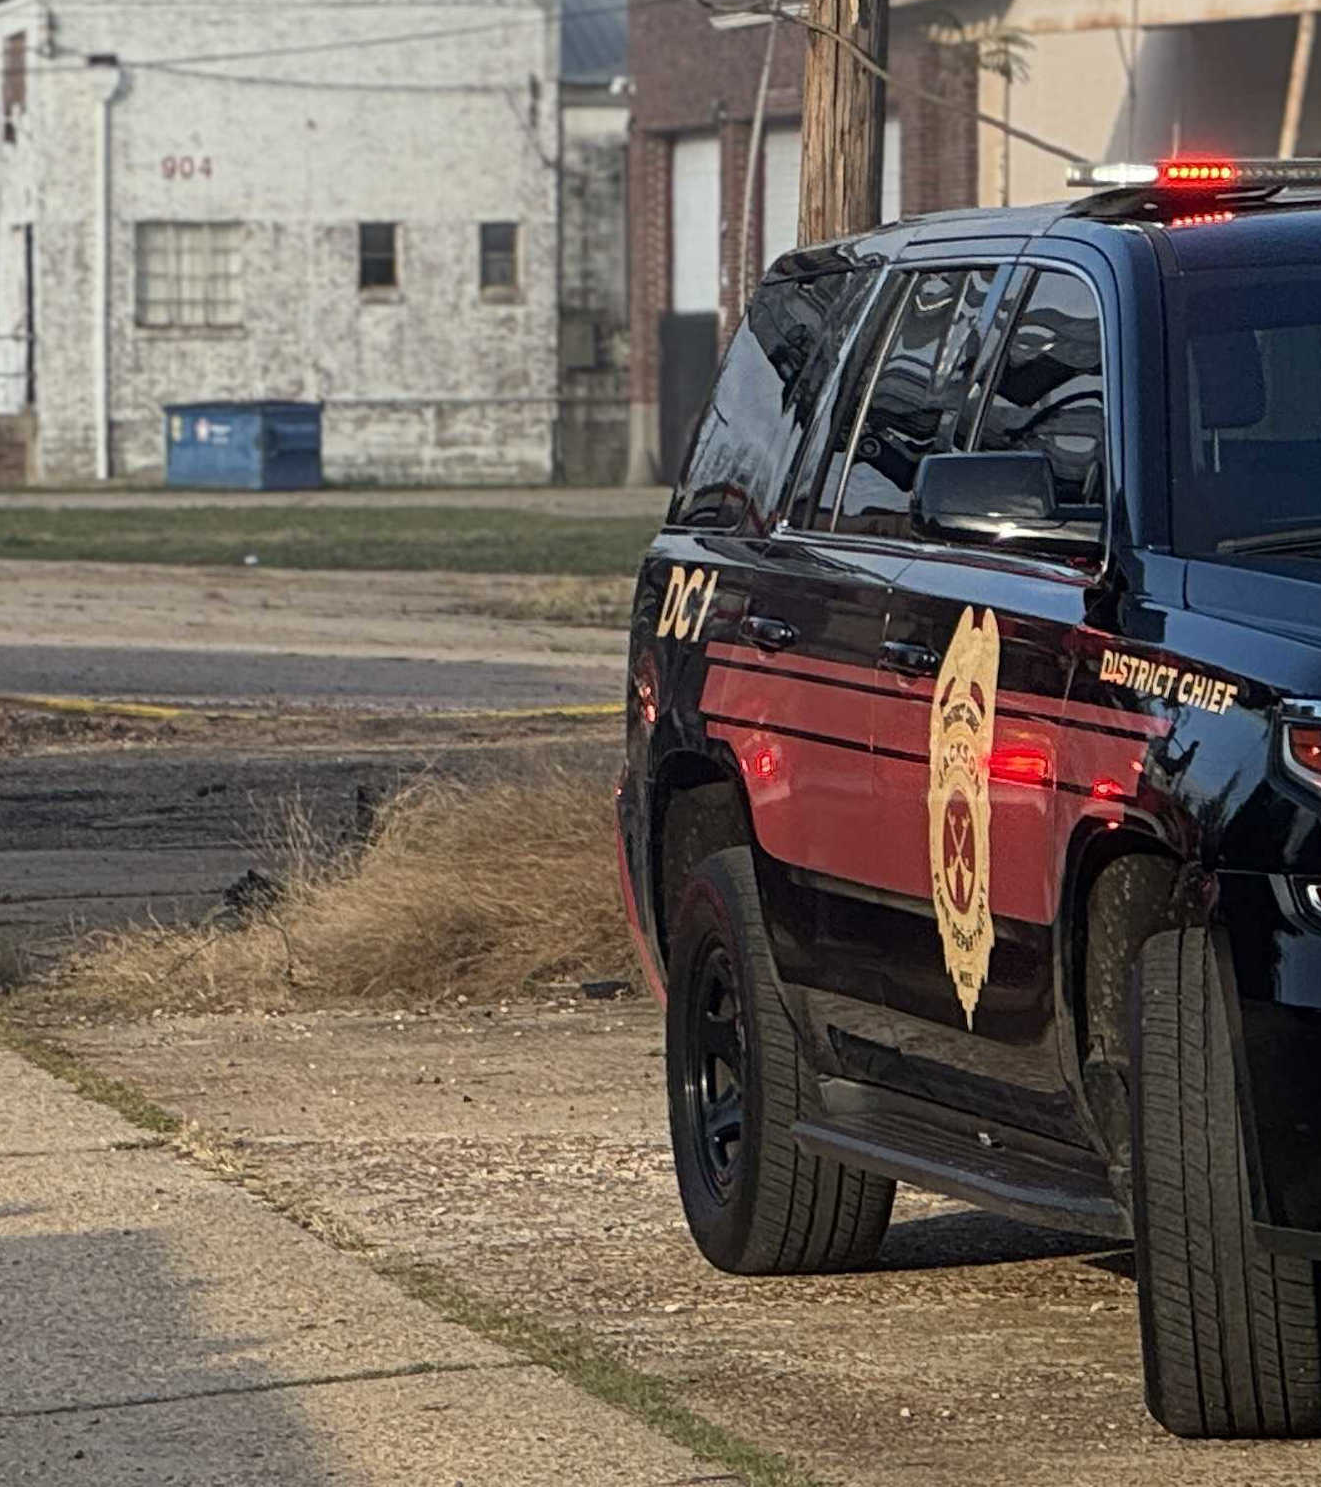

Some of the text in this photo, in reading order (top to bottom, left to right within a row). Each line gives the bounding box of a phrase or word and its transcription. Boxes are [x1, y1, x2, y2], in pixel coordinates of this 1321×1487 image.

[161, 155, 213, 181] 904
[656, 565, 719, 642] DC1
[1099, 649, 1239, 715] DISTRICT CHIEF
